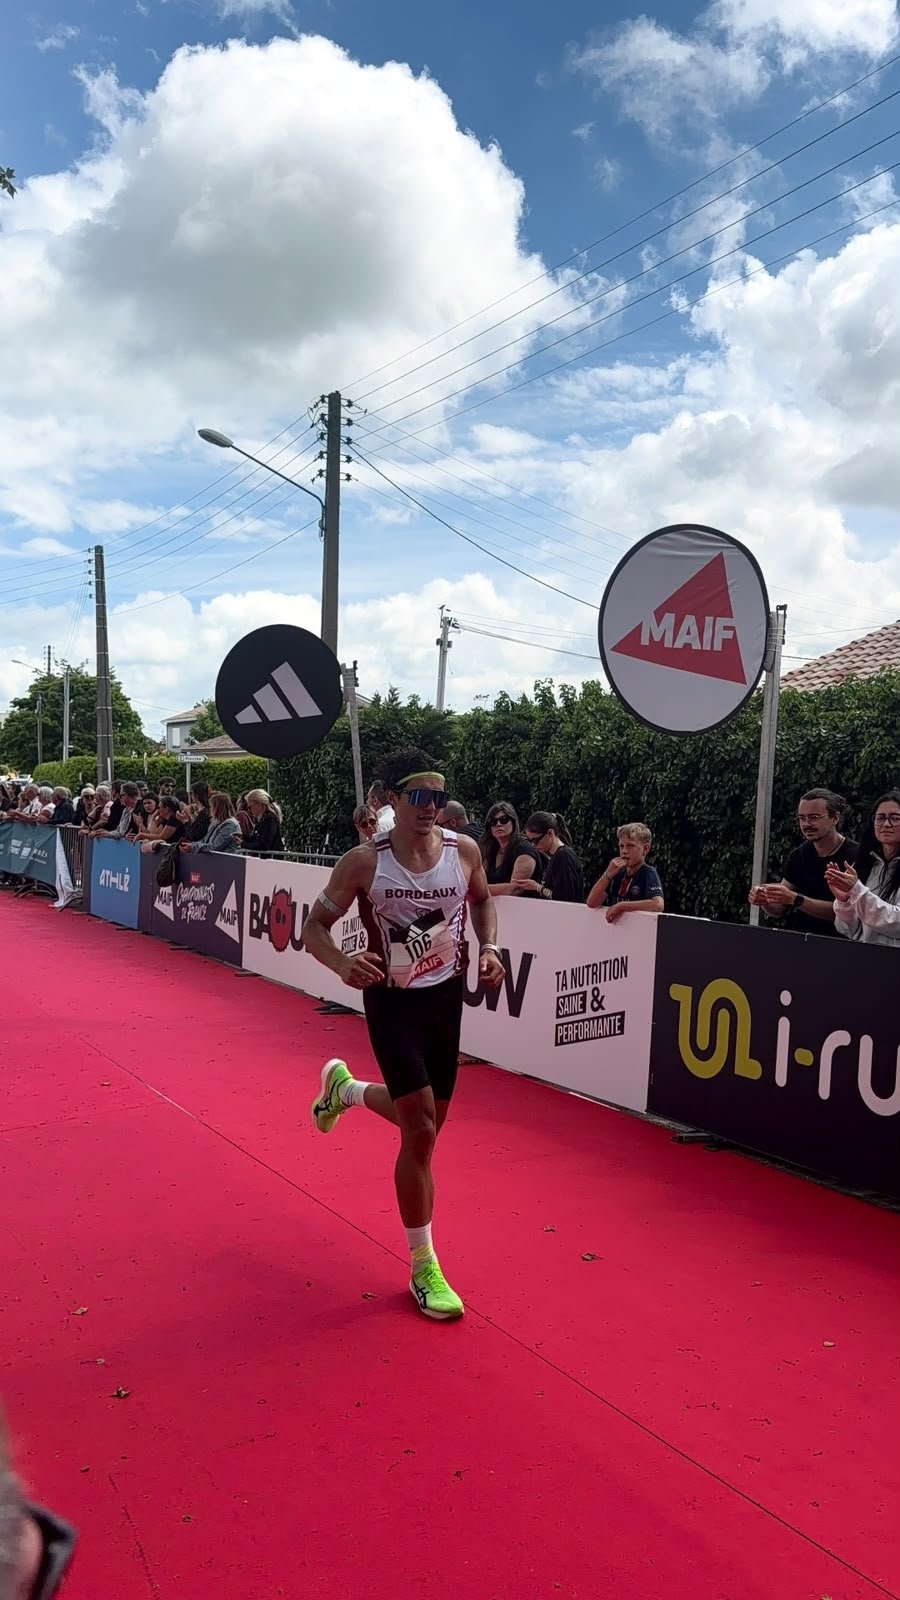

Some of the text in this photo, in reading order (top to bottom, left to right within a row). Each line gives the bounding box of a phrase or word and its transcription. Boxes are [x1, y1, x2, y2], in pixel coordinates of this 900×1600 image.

[641, 613, 736, 651] MAIF
[385, 887, 457, 899] BORDEAUX
[219, 907, 238, 926] MAIF
[405, 933, 432, 963] 106
[412, 954, 442, 977] MAIF
[555, 956, 628, 992] TA NUTRITION
[558, 987, 606, 1016] SAINE &
[557, 1015, 621, 1044] PERFORMANTE
